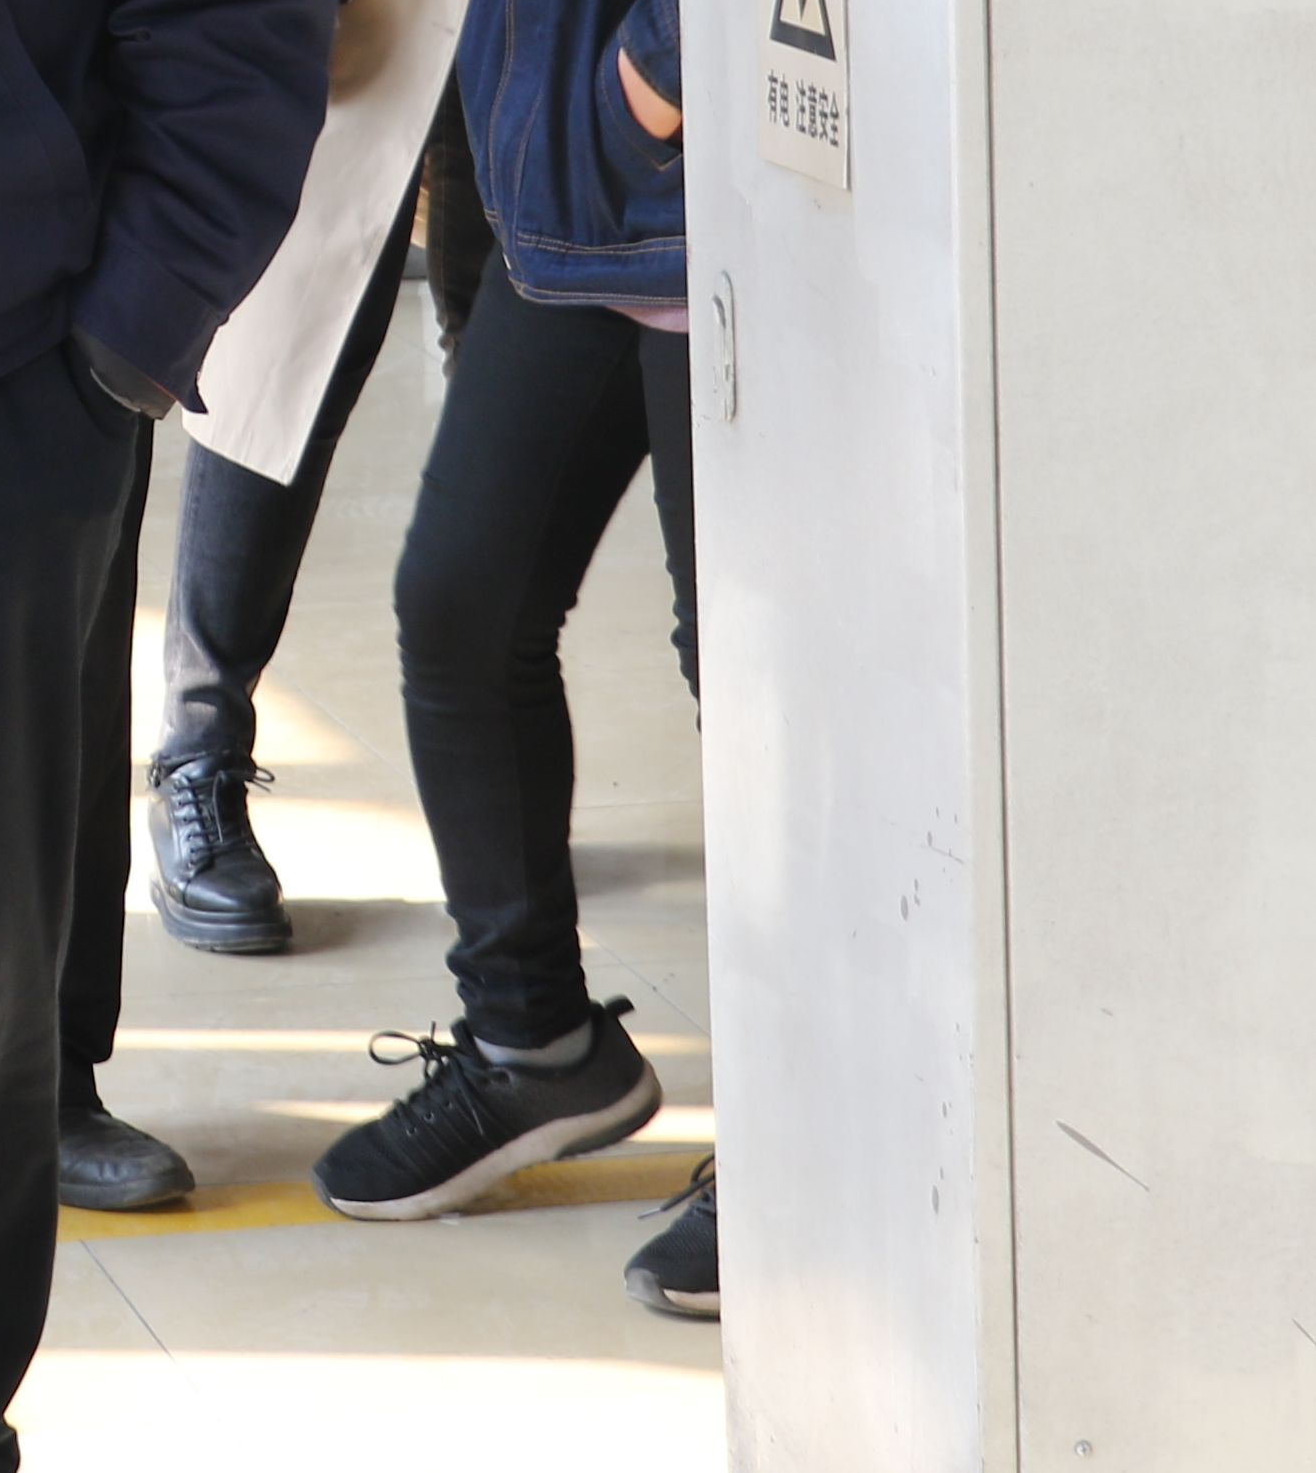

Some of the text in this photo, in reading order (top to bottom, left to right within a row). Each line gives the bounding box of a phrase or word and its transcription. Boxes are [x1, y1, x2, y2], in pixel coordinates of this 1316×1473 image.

[767, 69, 840, 148] 有电 注意安全
